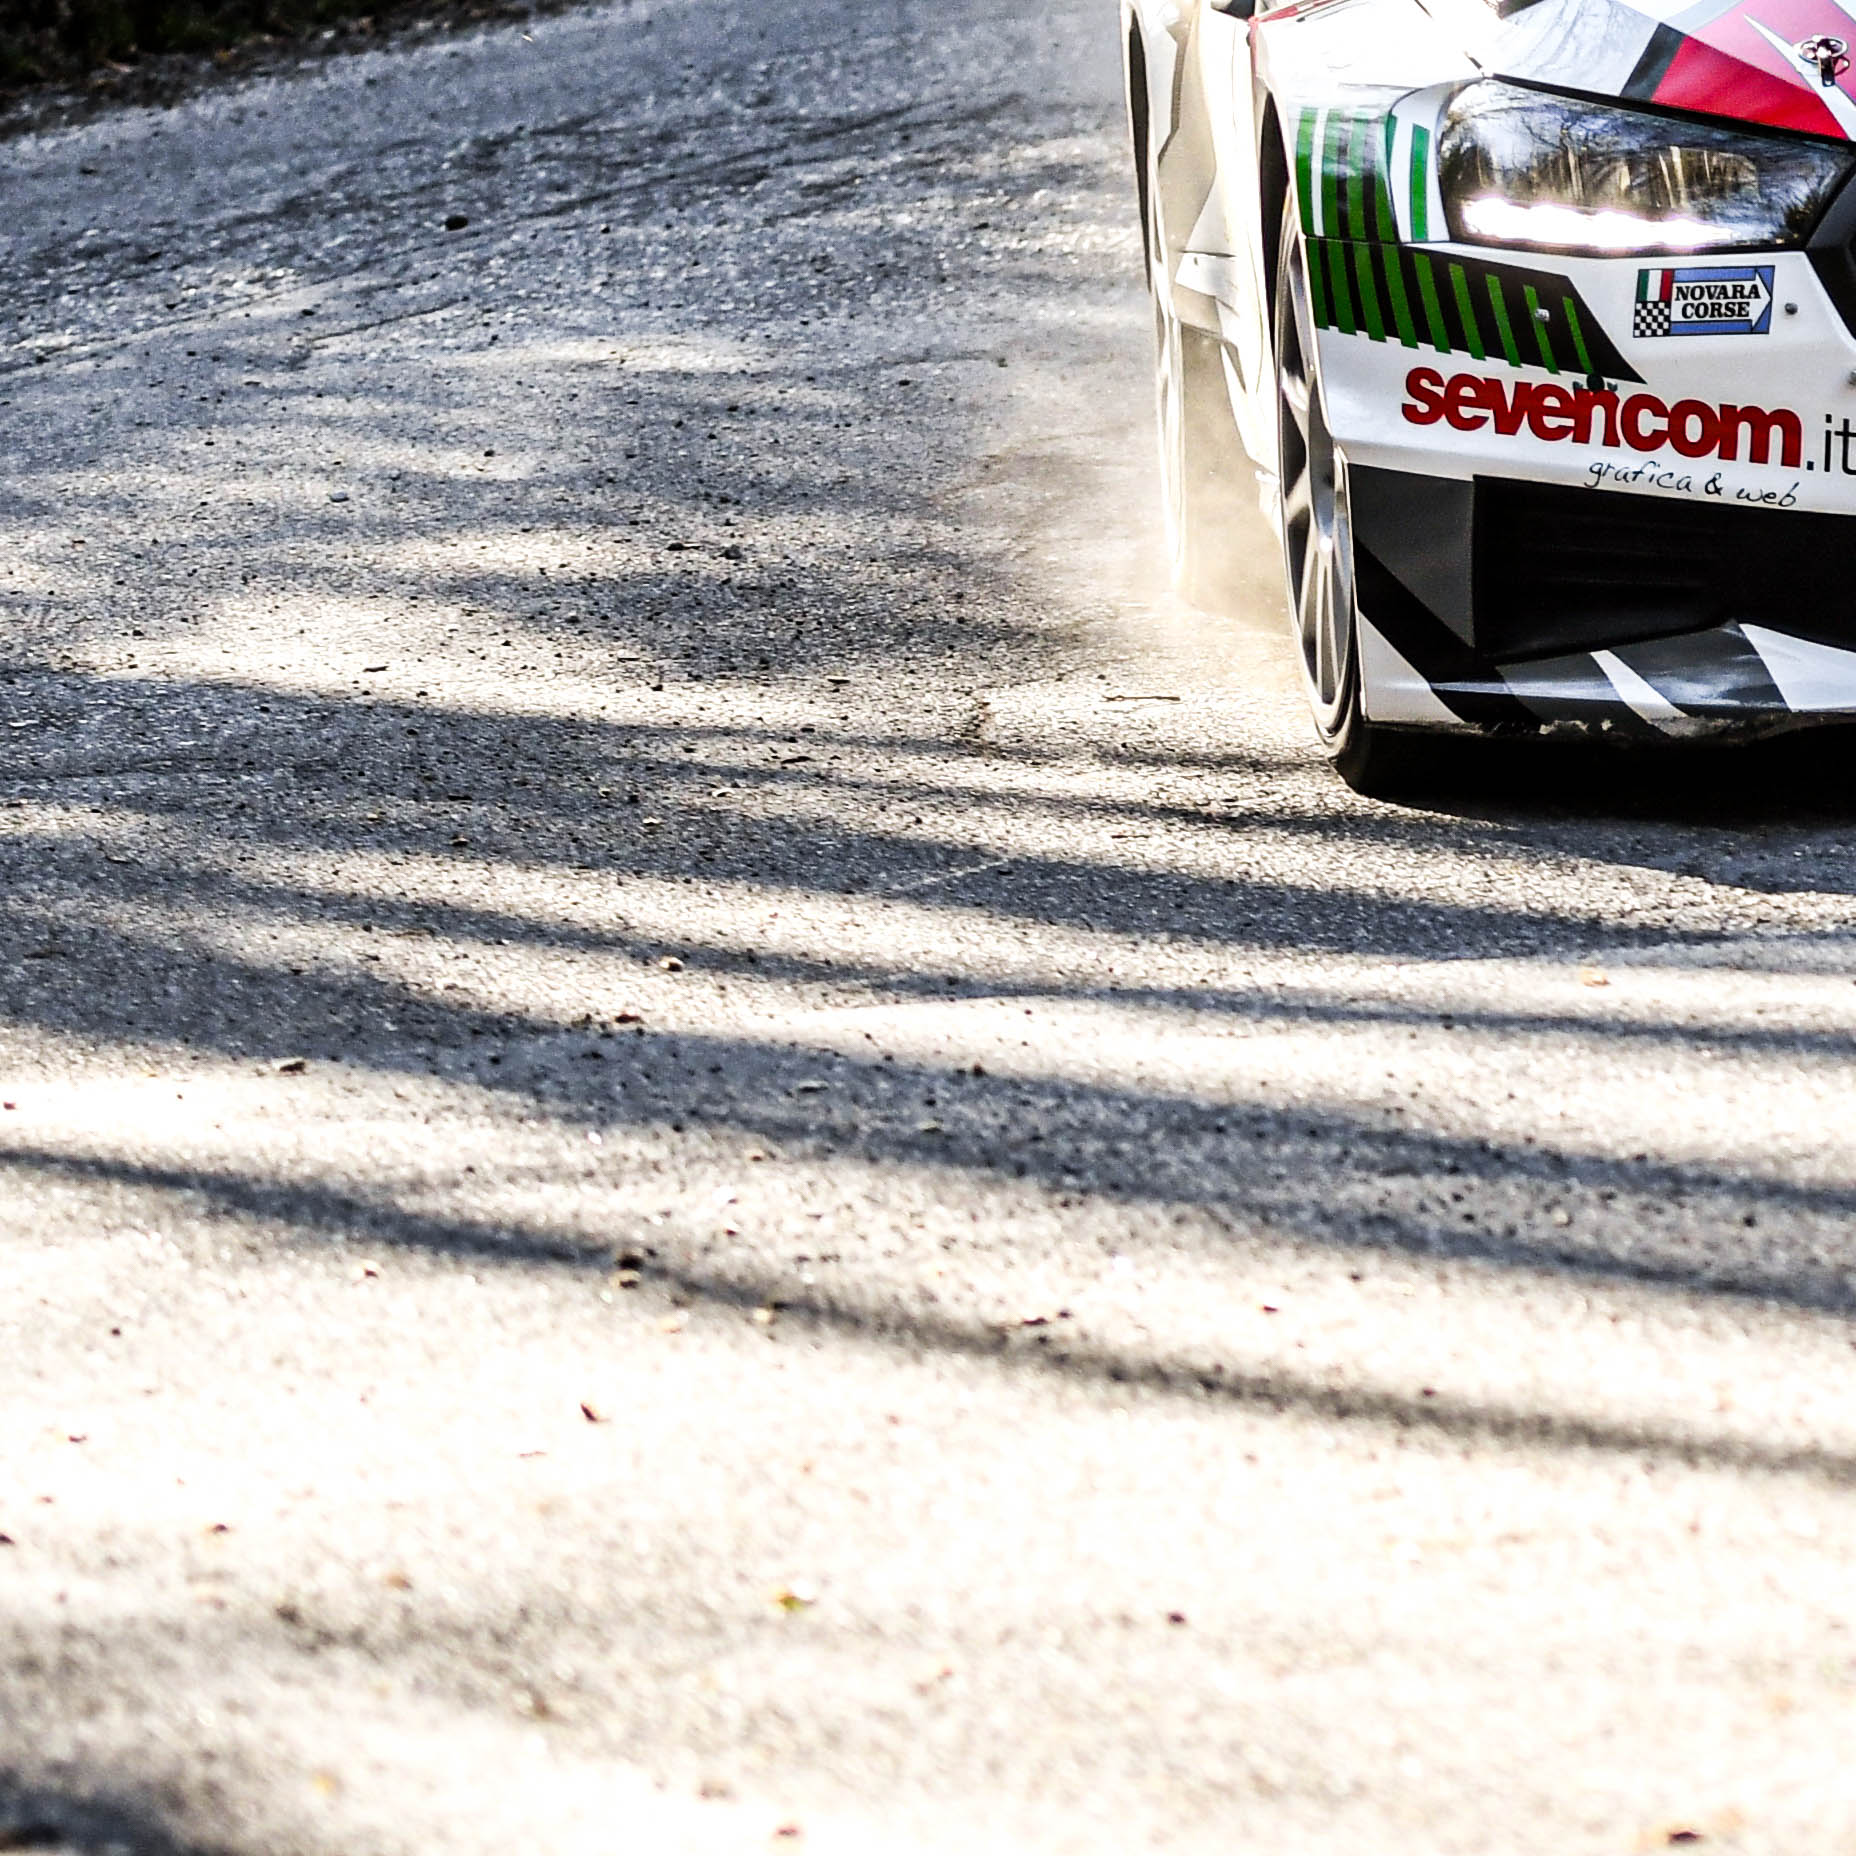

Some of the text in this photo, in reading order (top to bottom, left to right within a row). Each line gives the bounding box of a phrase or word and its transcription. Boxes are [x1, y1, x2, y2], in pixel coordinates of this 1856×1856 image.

[1674, 283, 1762, 302] NOVARA
[1681, 301, 1751, 320] CORSE
[1583, 459, 1801, 508] grafica & web
